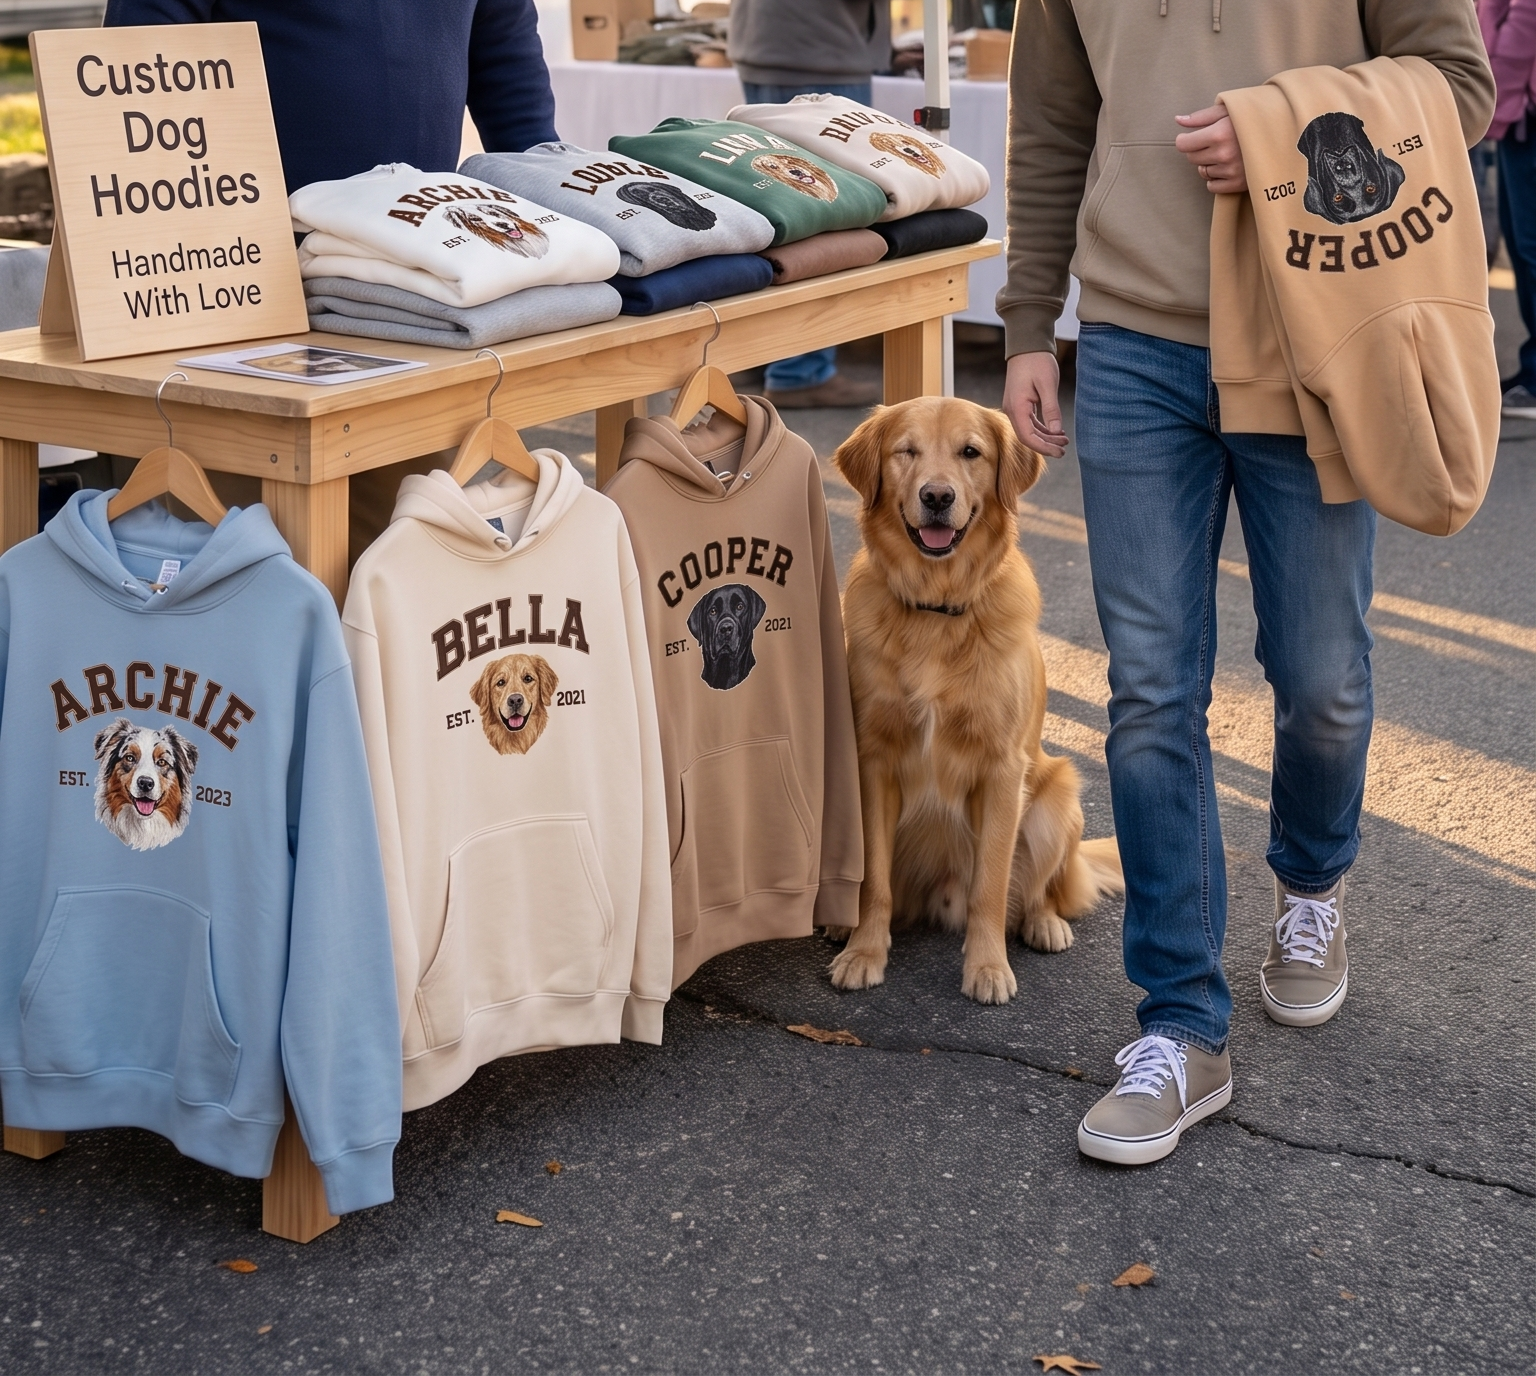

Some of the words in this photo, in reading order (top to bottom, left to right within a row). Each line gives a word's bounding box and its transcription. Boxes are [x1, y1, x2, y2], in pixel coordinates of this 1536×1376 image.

[76, 53, 235, 98] Custom
[122, 111, 208, 160] Dog
[1392, 134, 1424, 156] EST.
[90, 164, 260, 217] Hoodies
[387, 184, 517, 227] ARCHIE
[1263, 181, 1296, 202] 2021
[442, 235, 470, 249] EST.
[1285, 186, 1454, 273] COOPER
[111, 236, 262, 279] Handmade
[123, 284, 190, 320] With
[198, 282, 262, 311] Love
[657, 536, 794, 608] COOPER
[431, 593, 590, 682] BELLA
[665, 638, 690, 657] EST.
[764, 616, 792, 633] 2021
[50, 660, 256, 752] ARCHIE
[446, 709, 475, 730] EST.
[556, 689, 586, 707] 2021
[59, 770, 90, 787] EST.
[195, 785, 232, 807] 2023
